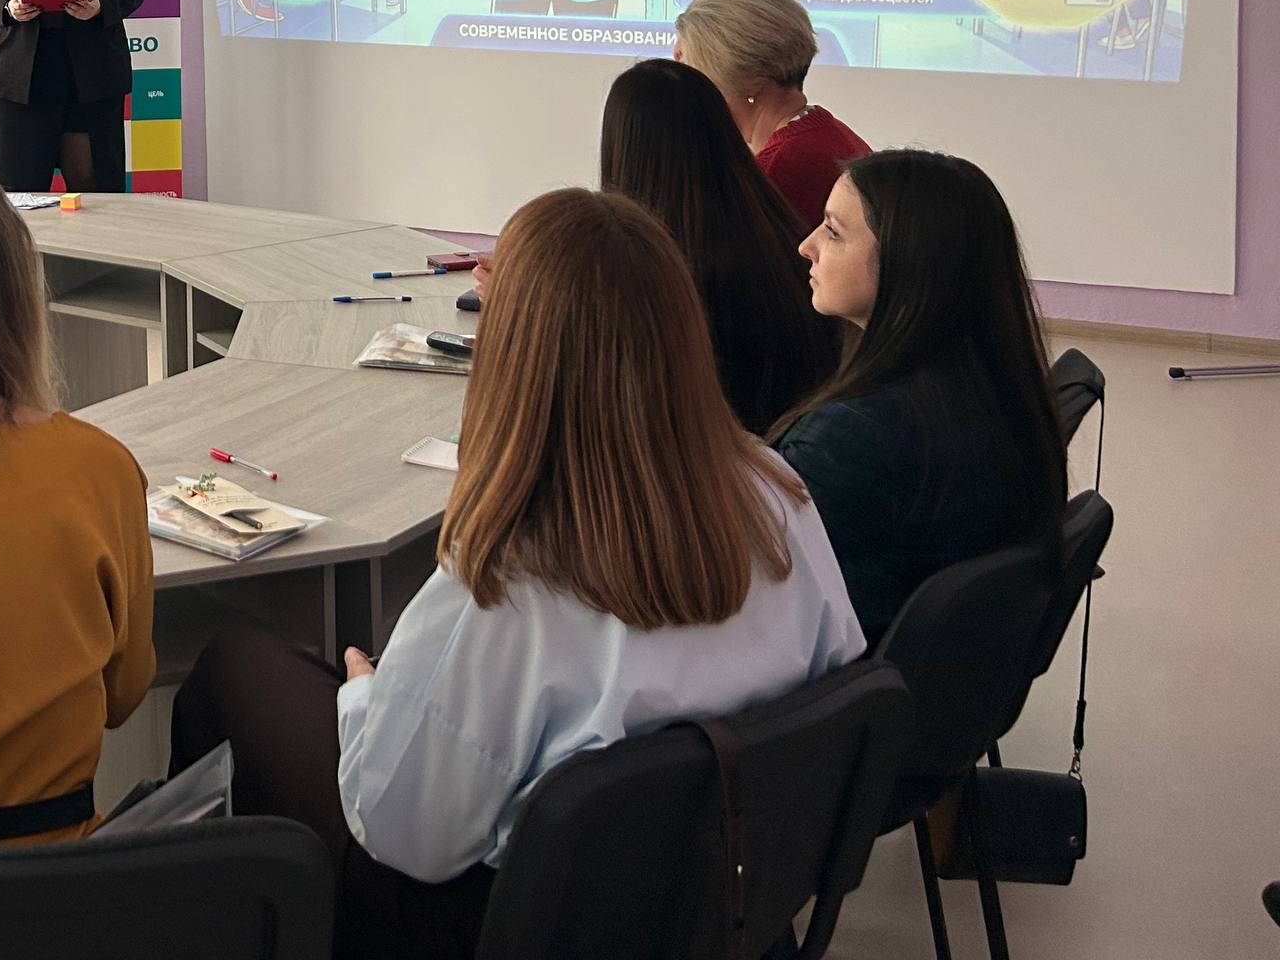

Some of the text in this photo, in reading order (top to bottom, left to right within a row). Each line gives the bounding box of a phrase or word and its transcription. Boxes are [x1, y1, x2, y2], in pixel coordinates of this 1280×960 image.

[459, 24, 678, 46] СОВРЕМЕННОЕ ОБРАЗОВАНИ
[147, 90, 164, 98] ЦЕЛЬ
